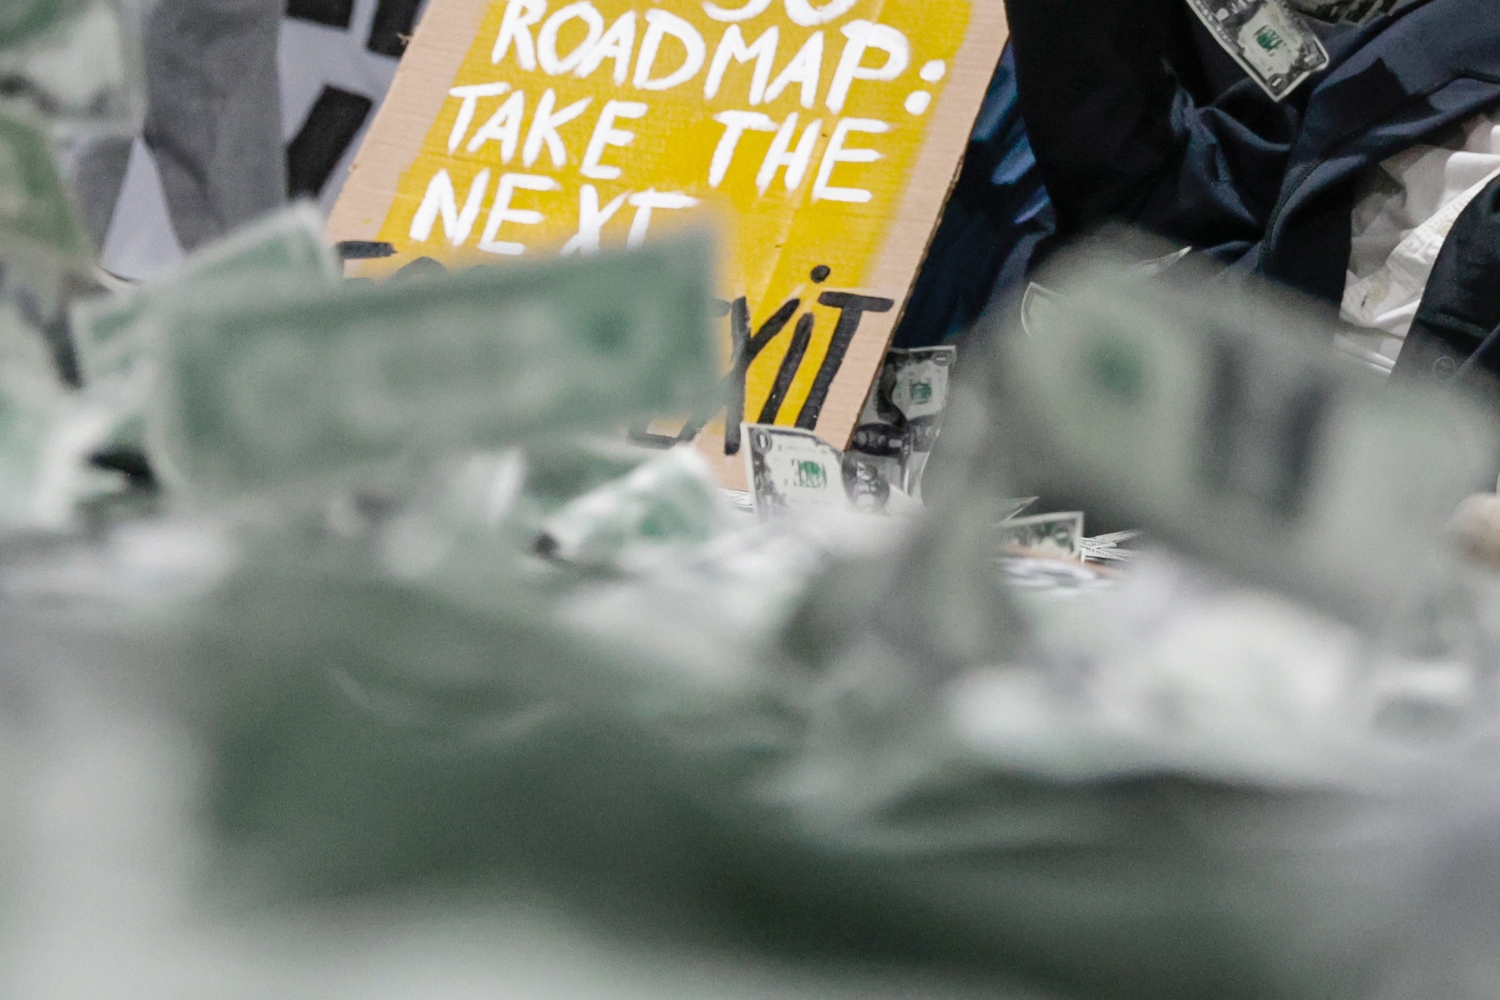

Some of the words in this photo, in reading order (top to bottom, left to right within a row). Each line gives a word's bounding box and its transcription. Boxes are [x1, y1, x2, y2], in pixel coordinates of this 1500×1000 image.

[449, 82, 648, 181] TAKE
[708, 109, 890, 204] THE
[408, 168, 699, 256] NEXT
